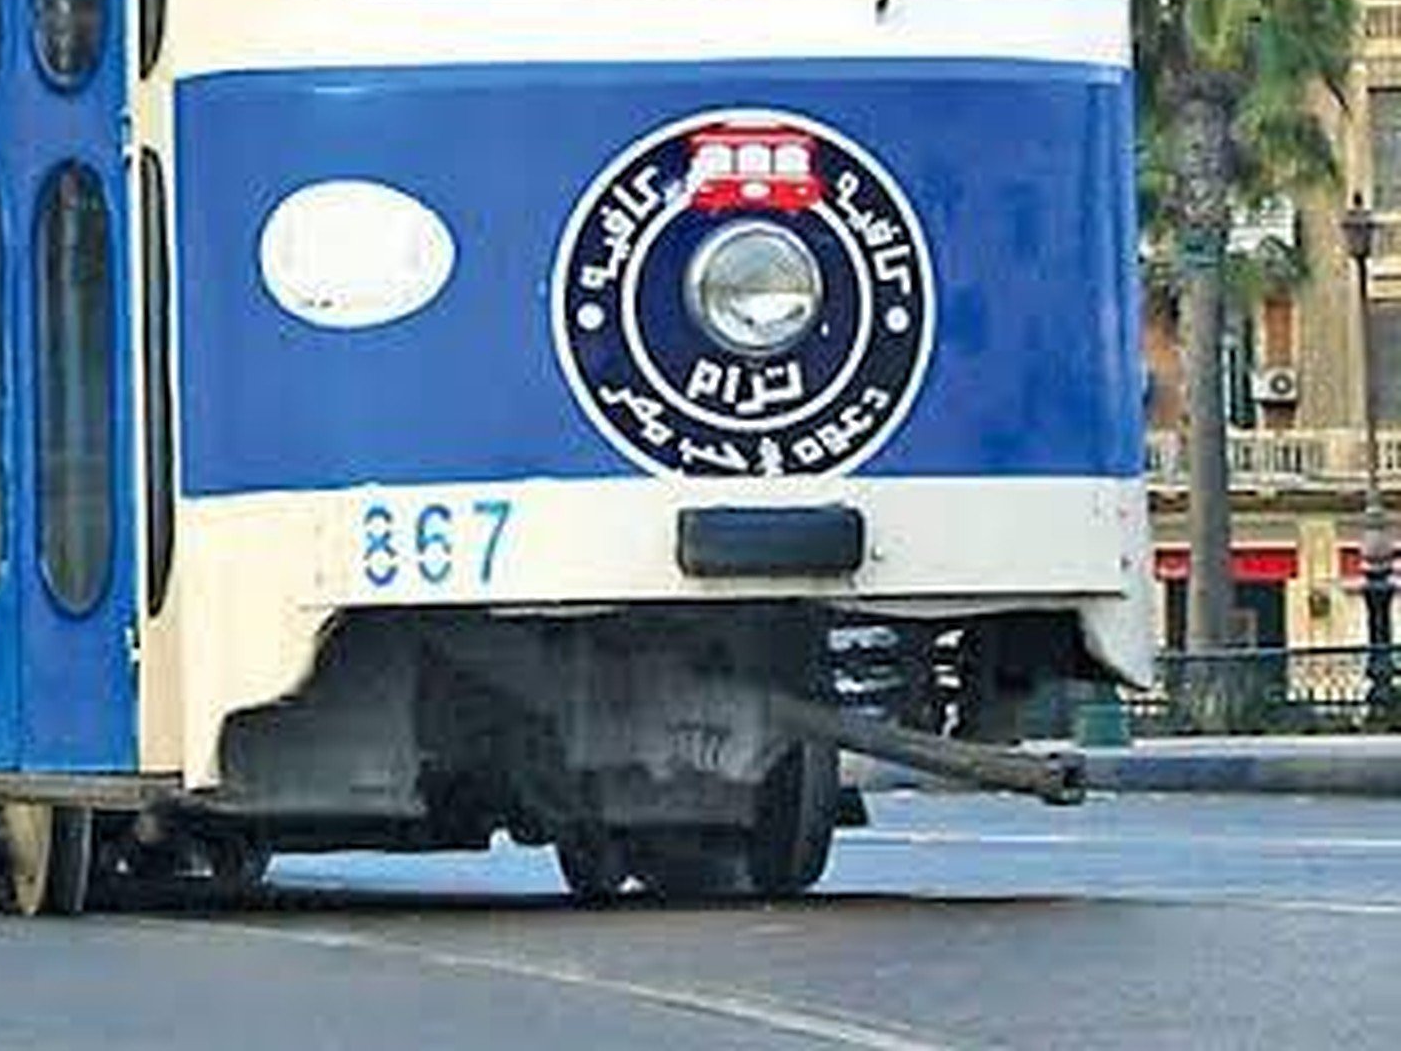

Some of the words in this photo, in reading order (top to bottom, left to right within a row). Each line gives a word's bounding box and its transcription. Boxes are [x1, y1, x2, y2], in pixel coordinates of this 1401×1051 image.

[579, 165, 659, 282] كافيه
[686, 359, 802, 414] ترام
[364, 500, 511, 586] 867
